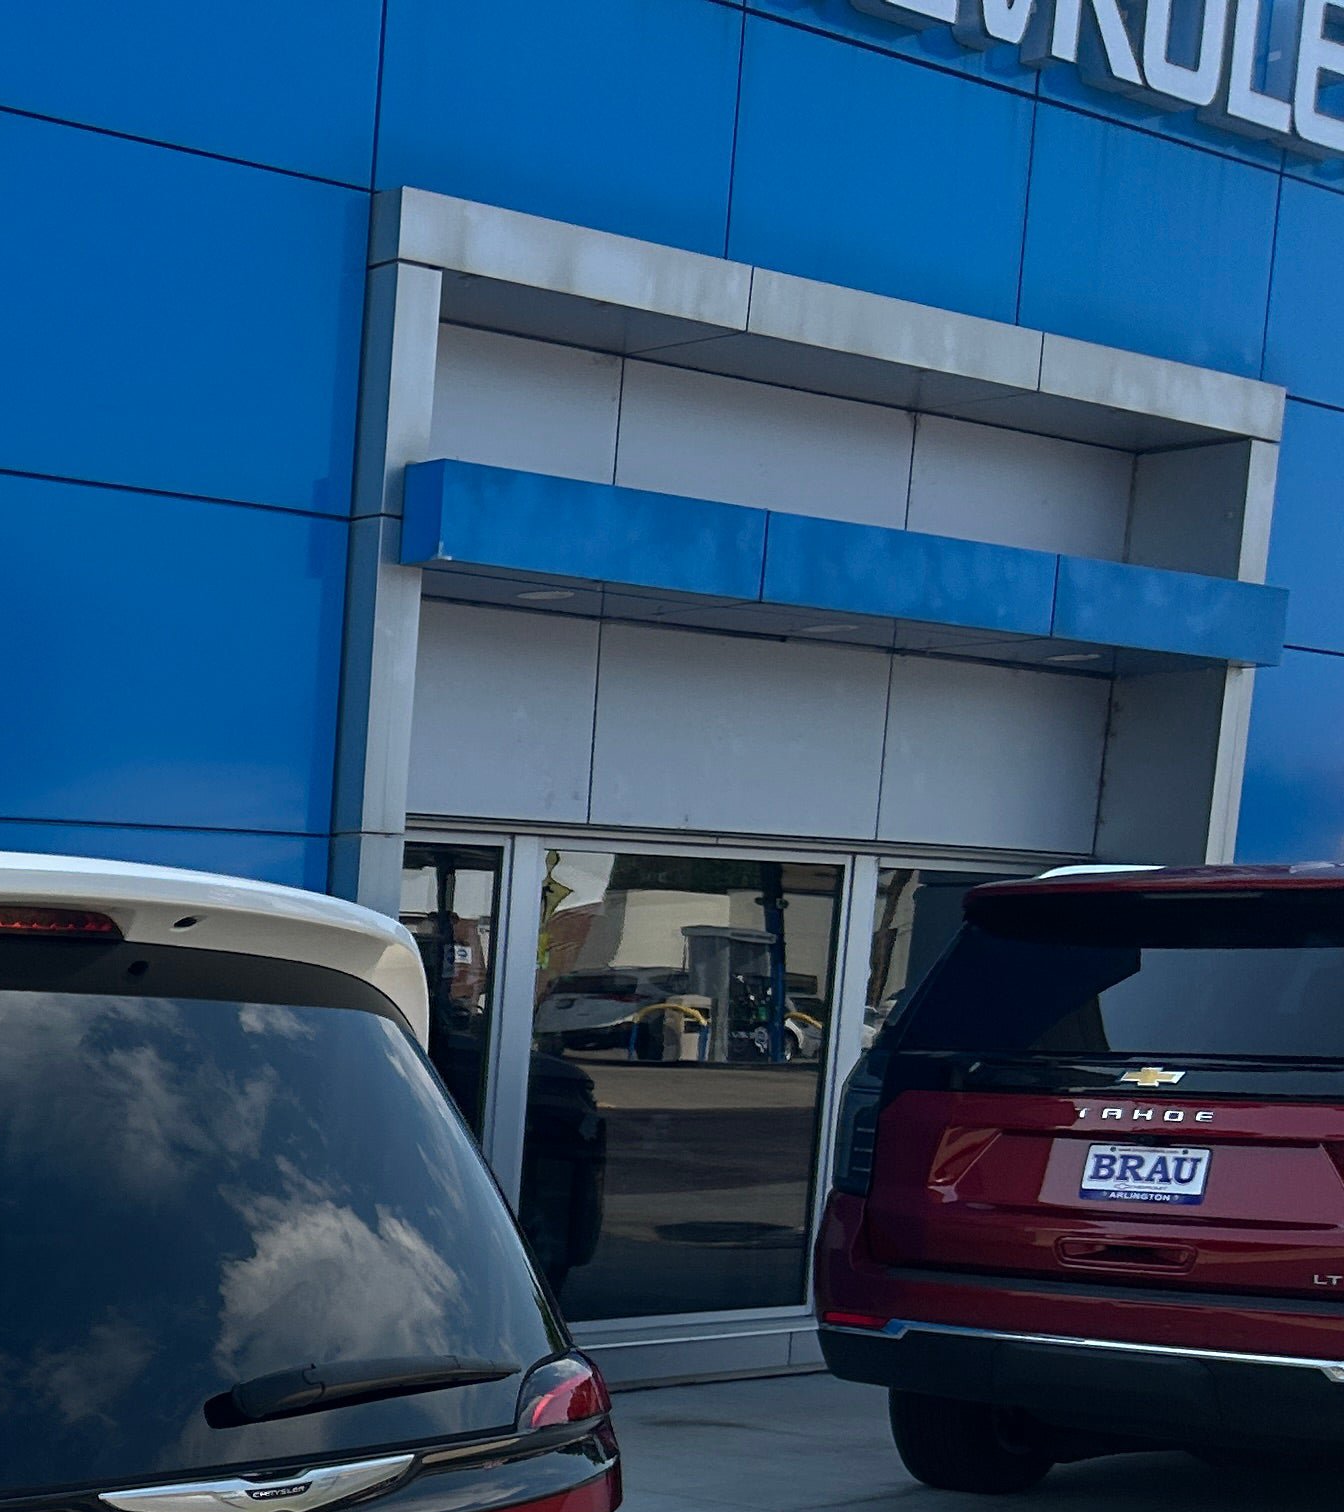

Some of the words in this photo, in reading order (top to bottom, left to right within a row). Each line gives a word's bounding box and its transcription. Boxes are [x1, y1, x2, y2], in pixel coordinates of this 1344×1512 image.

[1075, 1107, 1214, 1123] TAHOE
[1088, 1153, 1203, 1185] BRAU
[1108, 1191, 1172, 1202] ARLINGTON
[1313, 1274, 1344, 1286] LT
[252, 1485, 307, 1498] CHRYSLER
